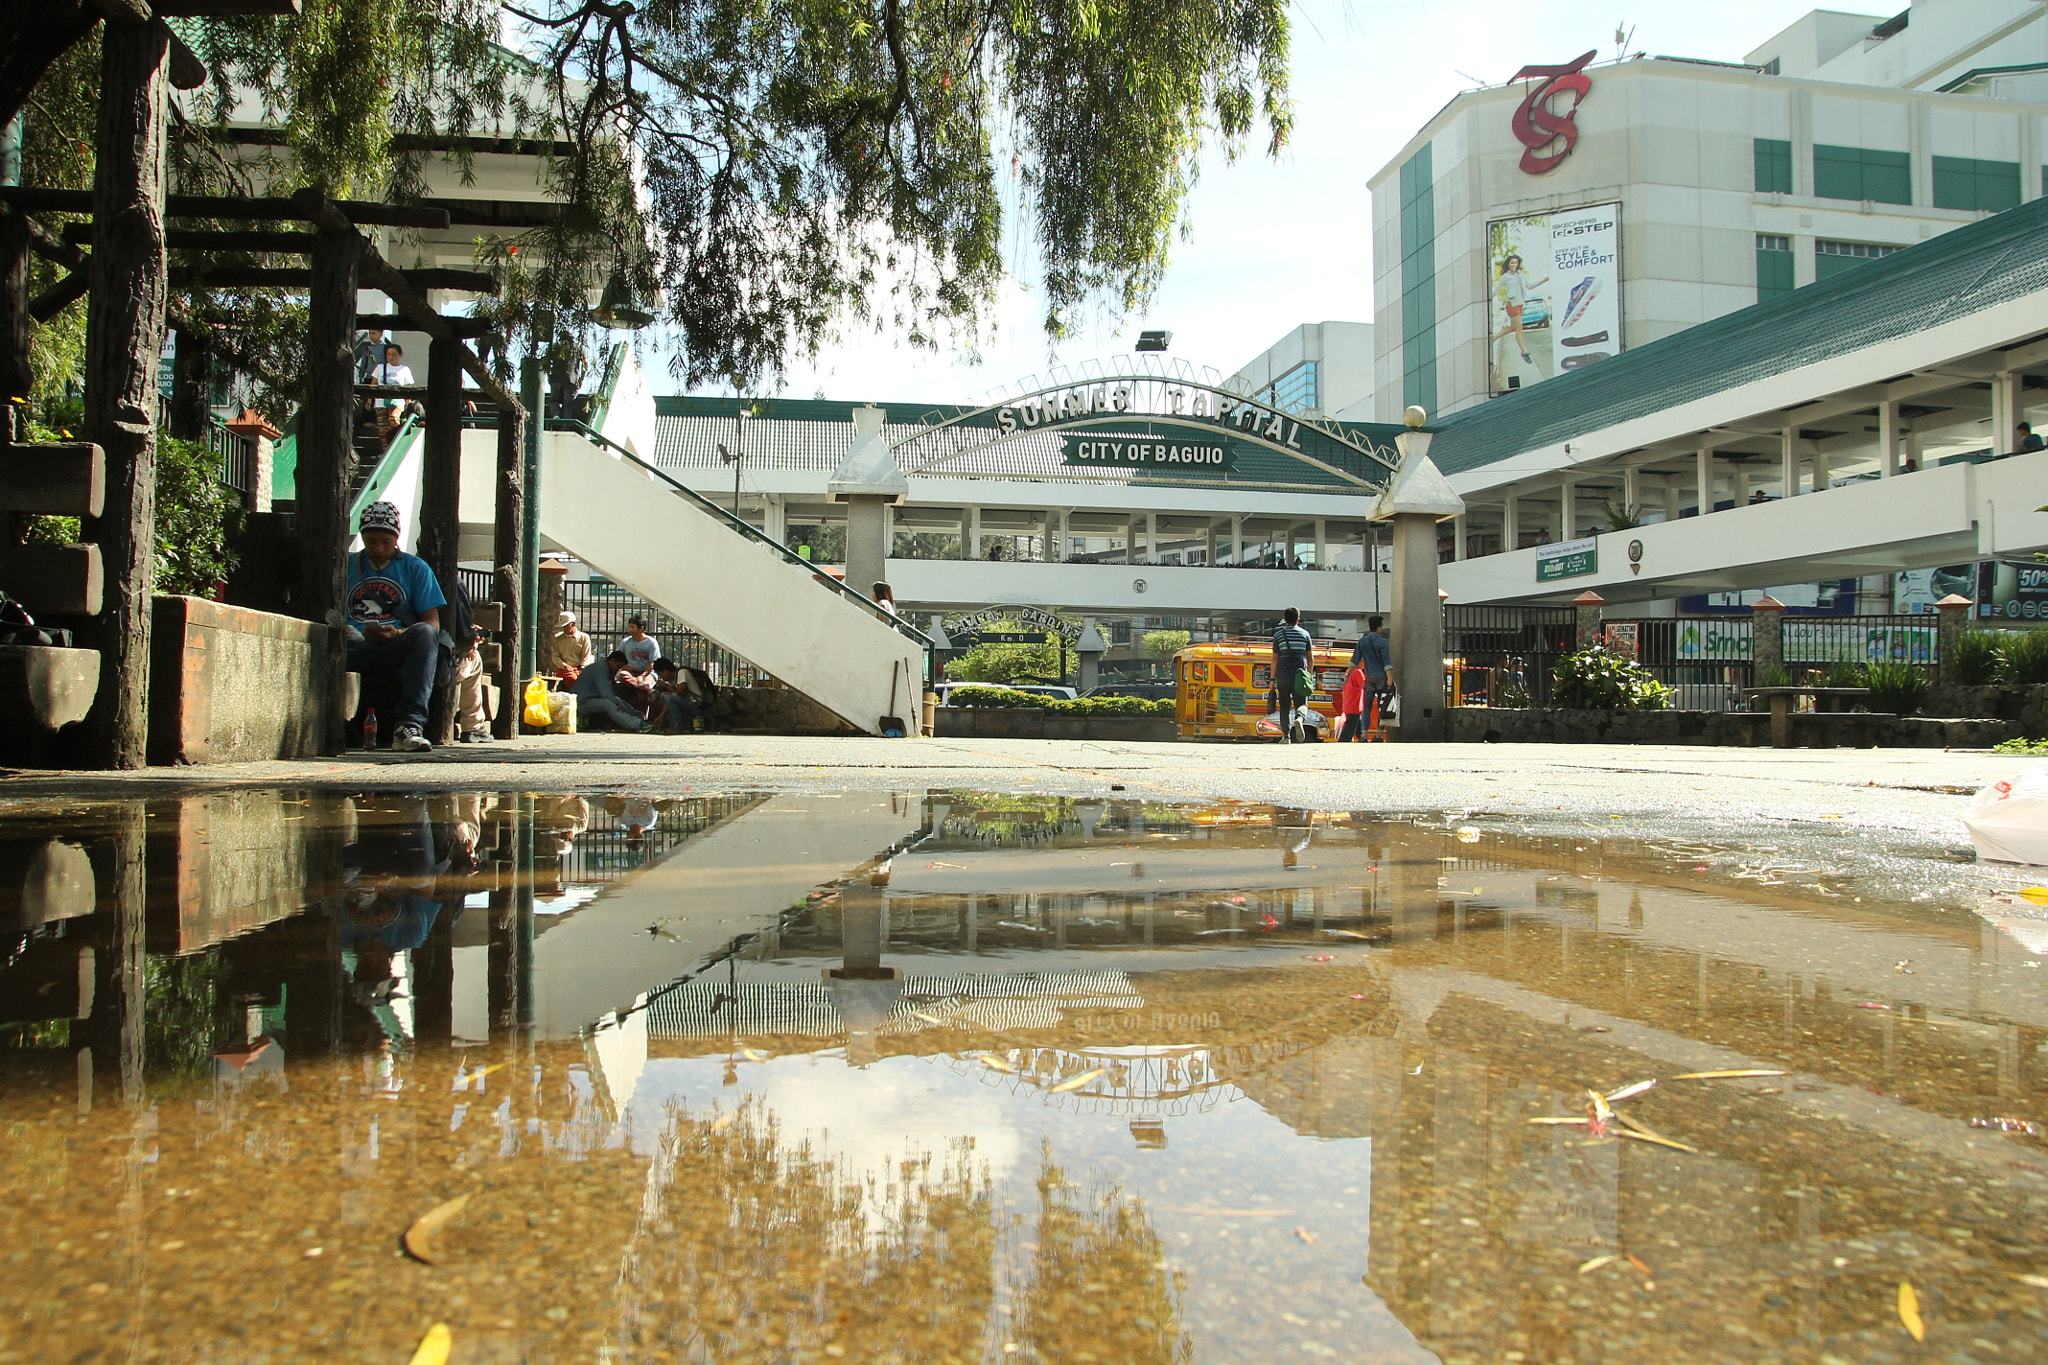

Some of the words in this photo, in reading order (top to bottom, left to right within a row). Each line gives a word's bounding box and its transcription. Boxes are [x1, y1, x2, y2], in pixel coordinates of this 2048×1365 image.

[1552, 218, 1597, 230] SKECHERS
[1555, 250, 1589, 262] STYLE
[1558, 254, 1614, 270] COMFORT
[996, 386, 1134, 434] SUMMER
[1168, 389, 1302, 450] CAPITAL
[1078, 442, 1122, 461] CITY
[1127, 443, 1150, 462] OF
[1155, 443, 1224, 464] BAGUIO
